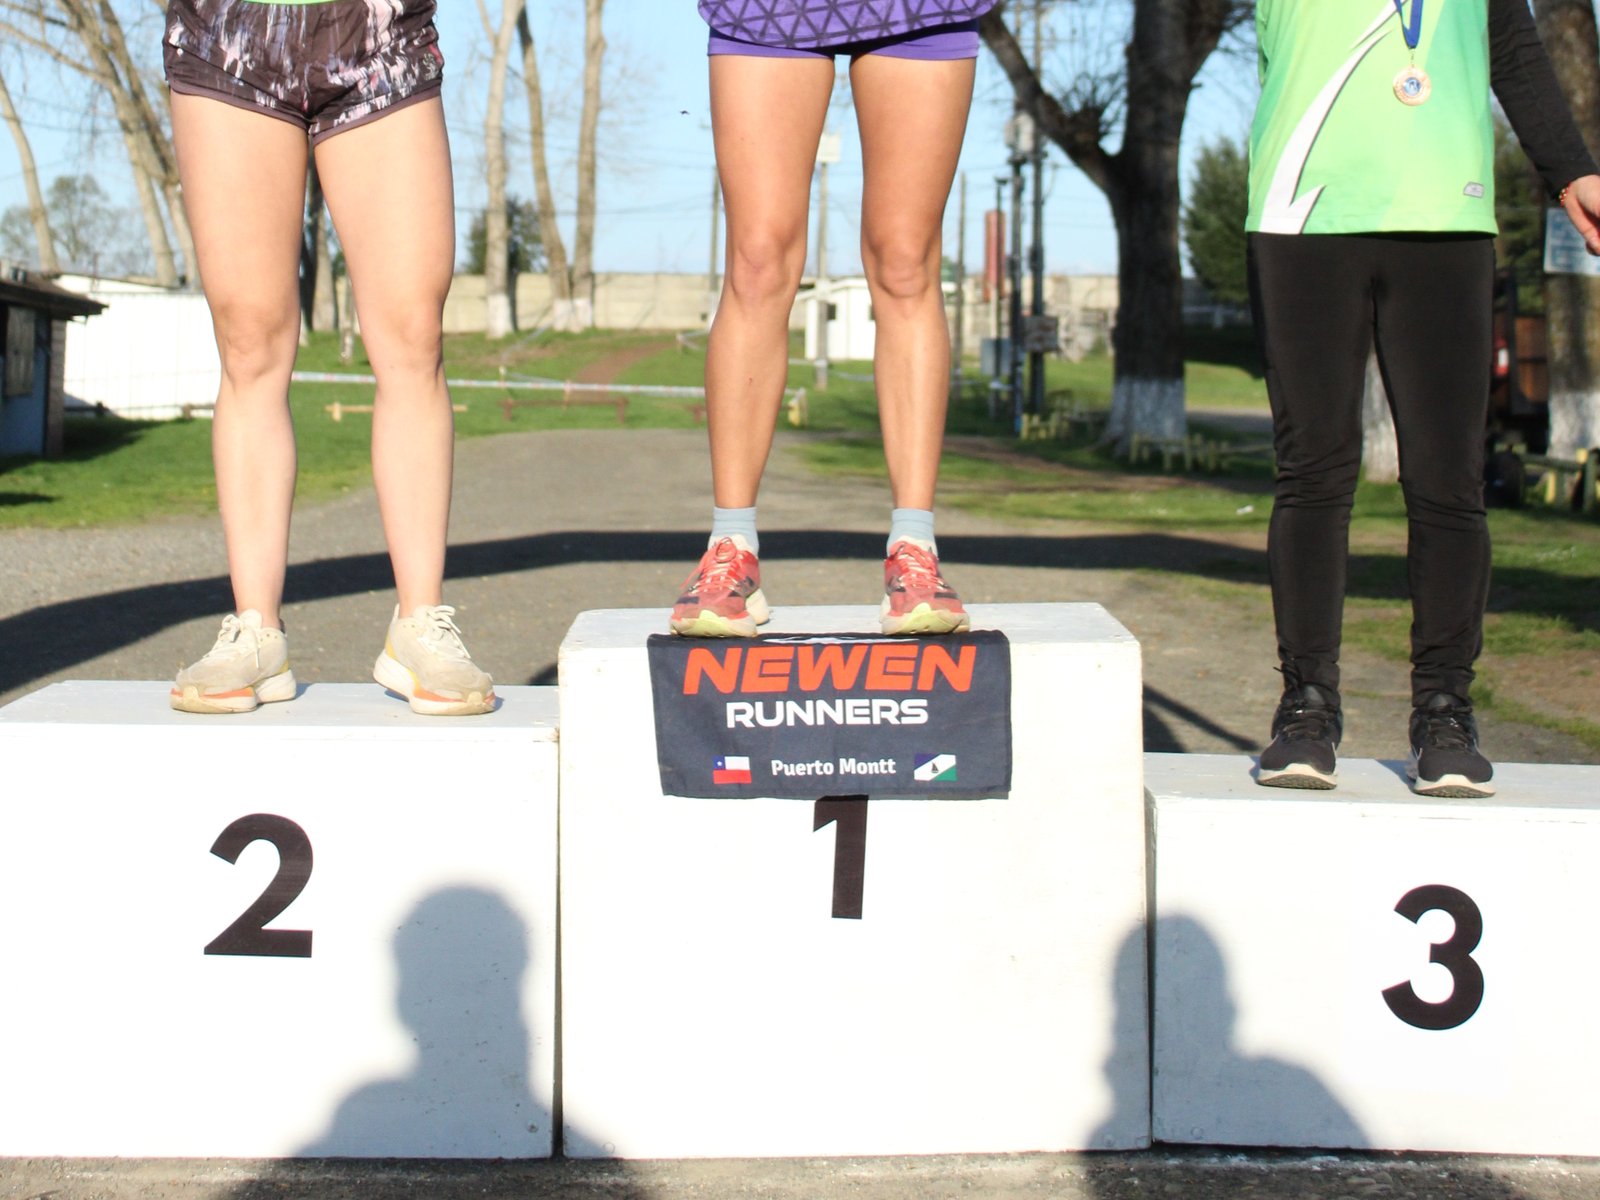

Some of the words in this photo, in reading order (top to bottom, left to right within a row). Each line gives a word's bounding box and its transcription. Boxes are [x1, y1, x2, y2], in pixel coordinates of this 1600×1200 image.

[682, 644, 977, 695] NEWEN
[726, 699, 929, 728] RUNNERS
[771, 759, 834, 776] Puerto
[838, 758, 896, 775] Montt
[204, 814, 312, 957] 2
[813, 796, 868, 920] 1
[1382, 884, 1484, 1030] 3
